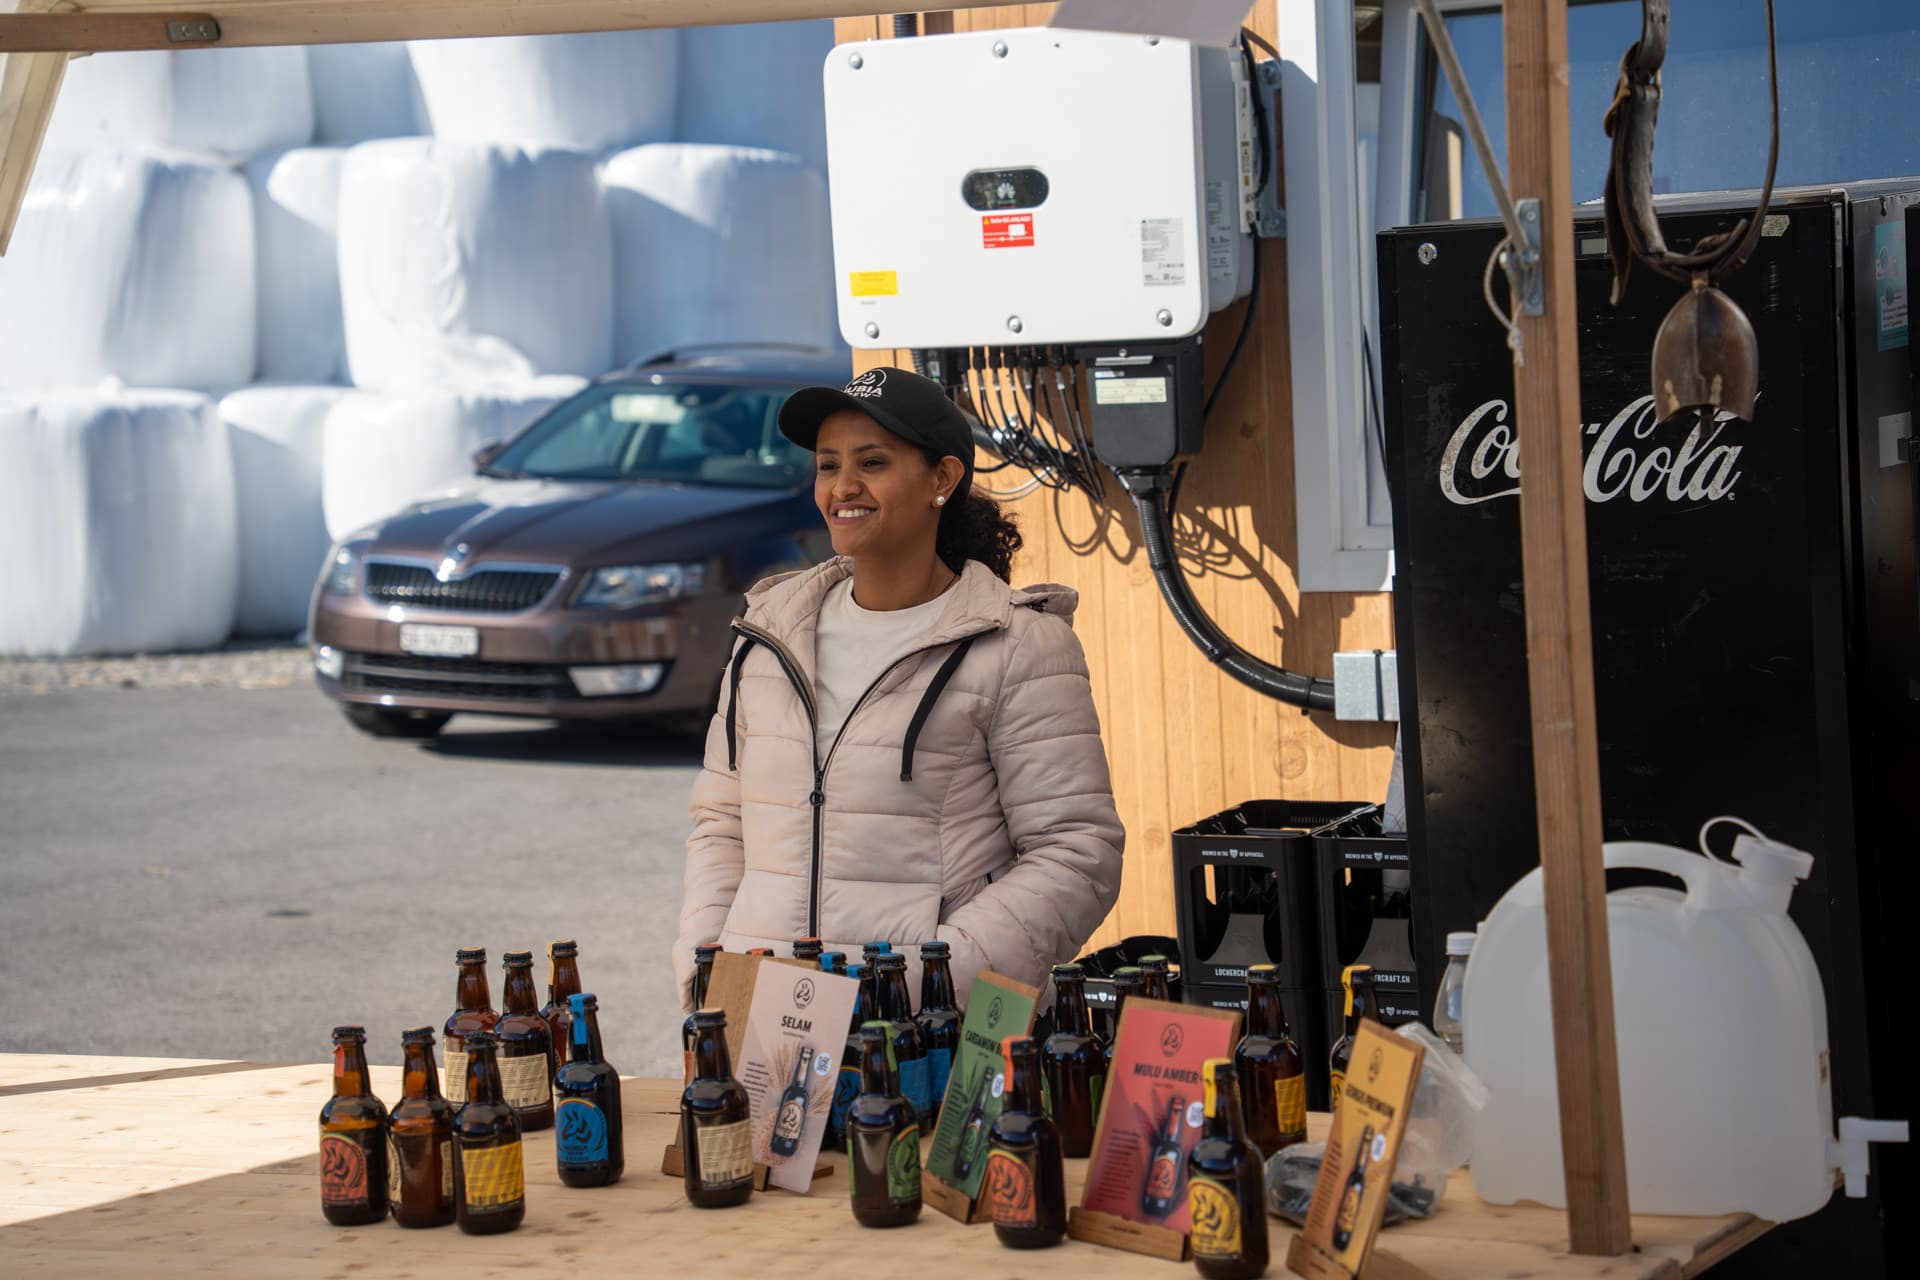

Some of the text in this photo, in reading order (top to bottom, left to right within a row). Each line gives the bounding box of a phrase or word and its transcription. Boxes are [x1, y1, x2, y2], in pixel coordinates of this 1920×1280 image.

[781, 1015, 812, 1033] SELAM
[1133, 1063, 1161, 1079] MULU
[1163, 1066, 1200, 1085] AMBER
